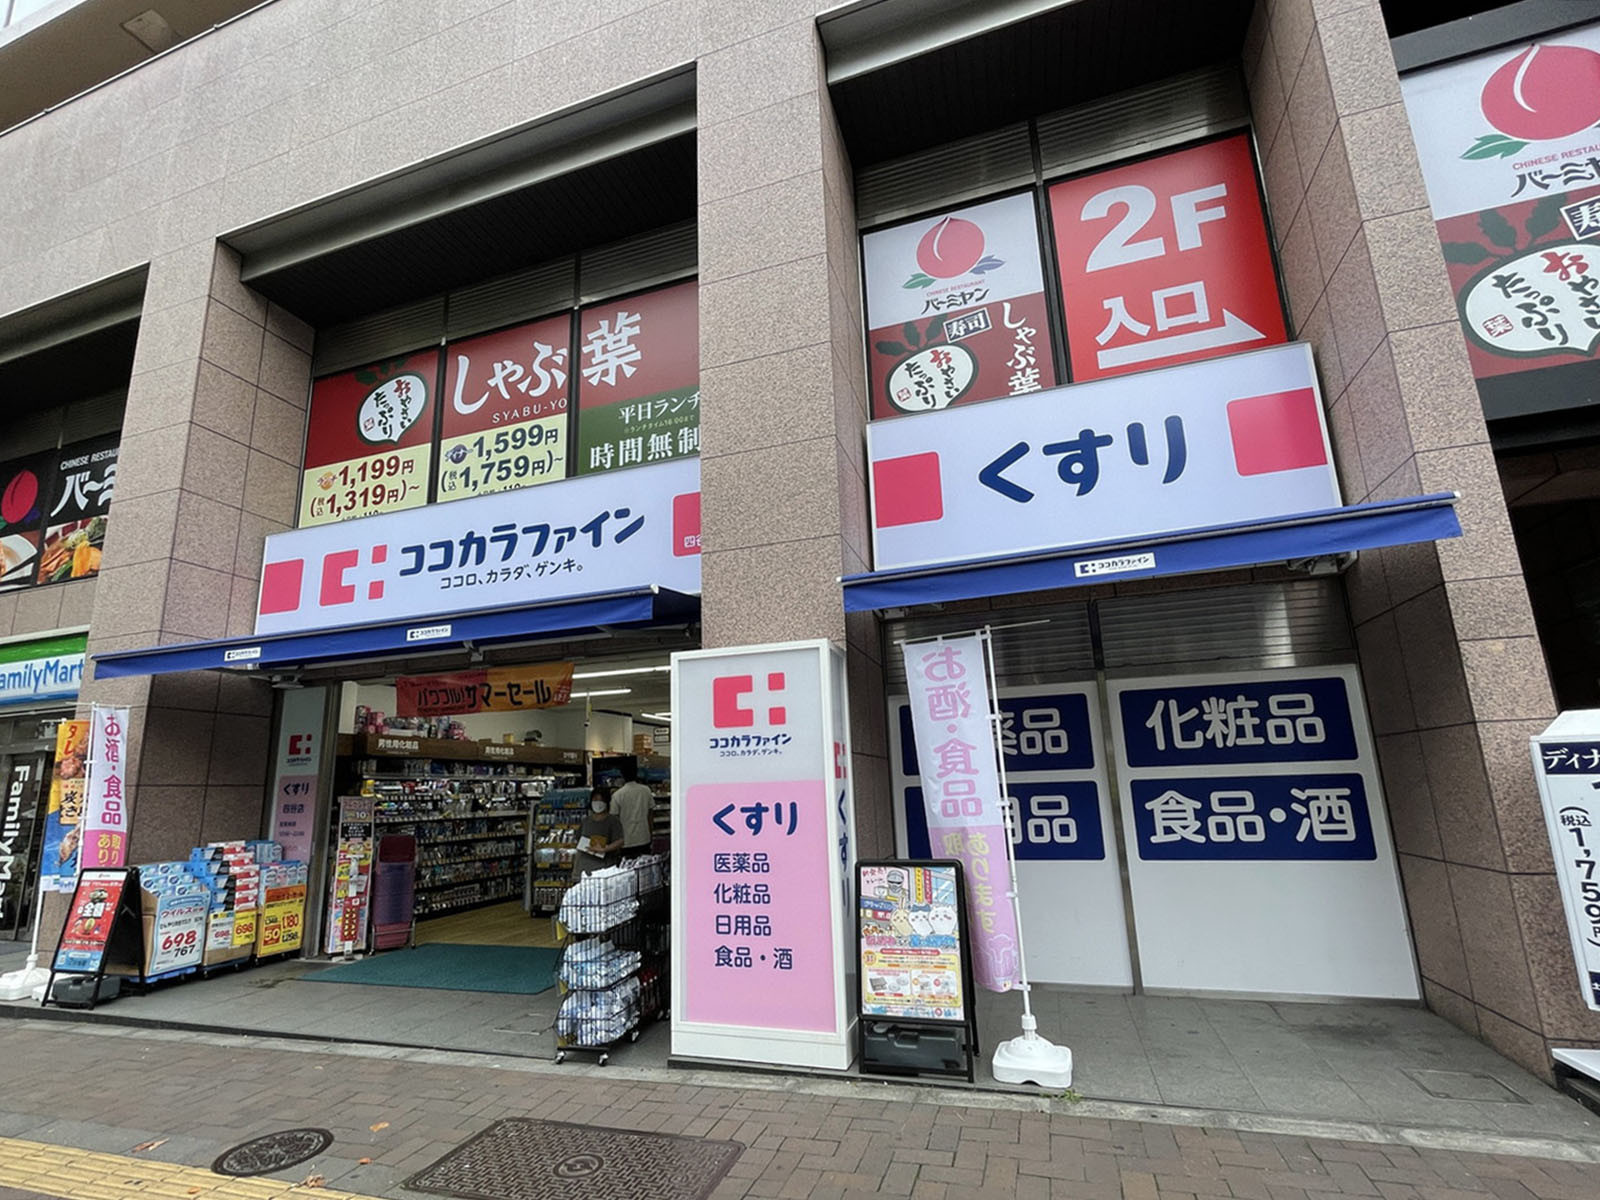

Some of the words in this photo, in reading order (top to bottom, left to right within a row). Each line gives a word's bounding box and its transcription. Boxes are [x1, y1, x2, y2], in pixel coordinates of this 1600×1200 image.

[1512, 154, 1559, 170] CHINESE
[1081, 183, 1227, 273] 2F
[921, 287, 990, 315] バーミヤン
[1095, 281, 1210, 346] 入口
[948, 311, 987, 339] 寿司
[492, 397, 568, 424] SYABU-YO
[473, 424, 558, 461] 1,599円
[338, 455, 414, 489] 1,199円
[978, 414, 1187, 504] くすり
[400, 507, 645, 577] ココカラファイン
[1145, 693, 1326, 750] 化粧品
[709, 733, 792, 749] ココカラファイン
[712, 801, 798, 836] くすり
[1145, 787, 1356, 843] 食品・酒
[713, 852, 770, 873] 医薬品
[713, 883, 771, 904] 化粧品
[162, 930, 198, 950] 698
[715, 915, 772, 937] 日用品
[173, 944, 196, 958] 767
[714, 945, 793, 970] 食品・酒
